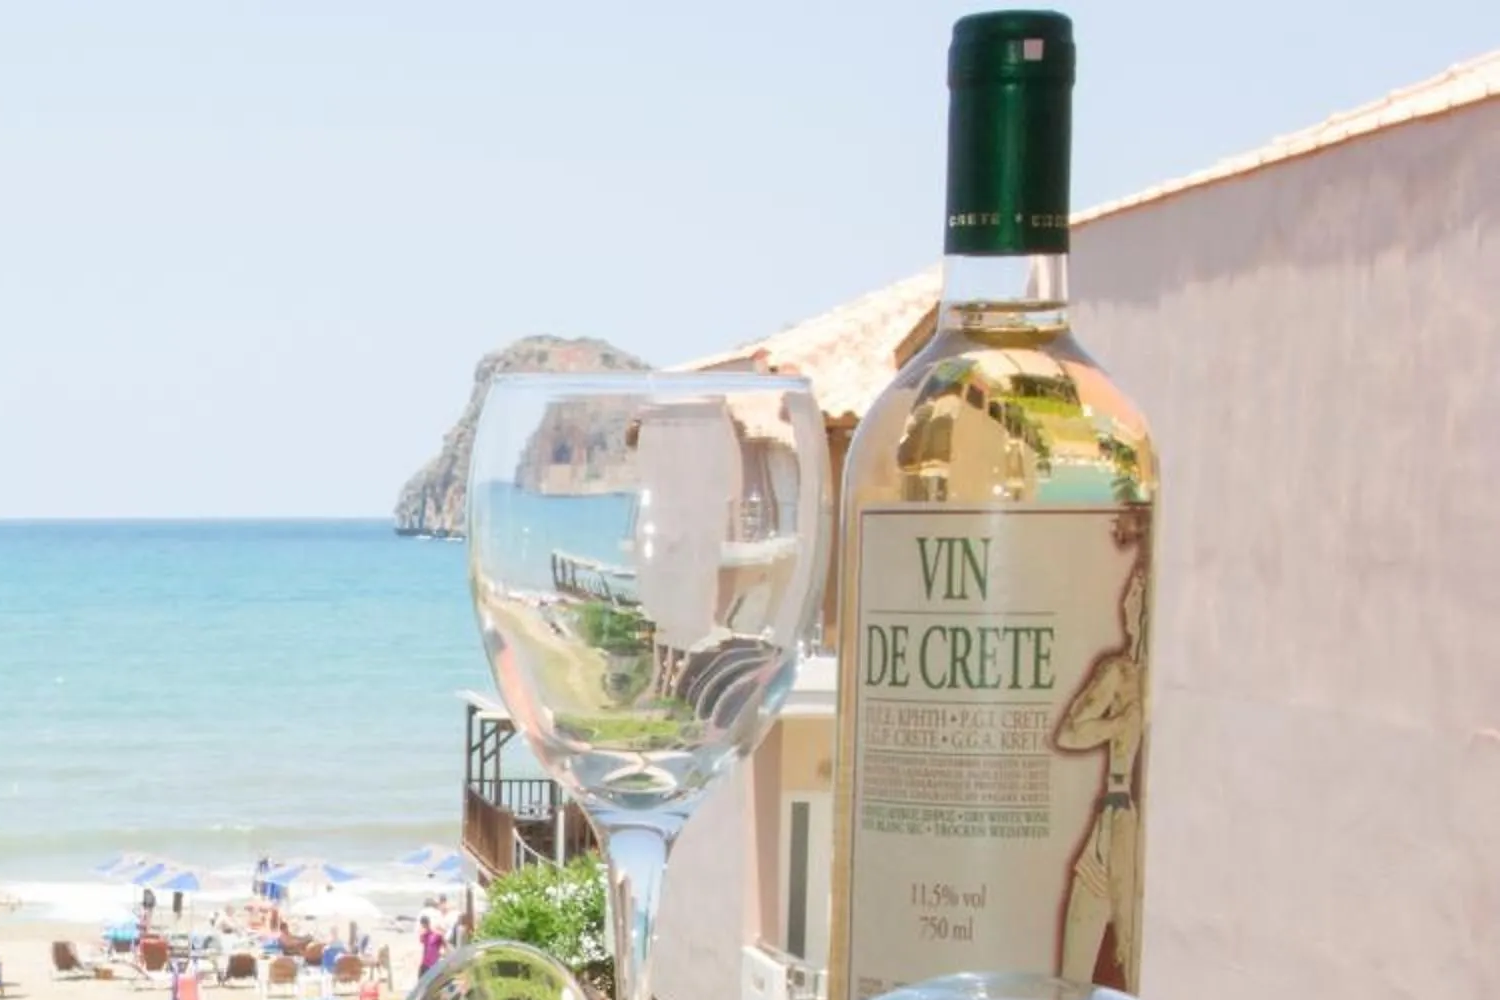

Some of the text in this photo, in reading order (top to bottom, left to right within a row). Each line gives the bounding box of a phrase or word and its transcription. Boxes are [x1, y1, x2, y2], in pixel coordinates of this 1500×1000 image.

[915, 537, 993, 602] VIN
[865, 624, 1056, 691] DE CRETE
[1000, 709, 1050, 730] CRETE
[962, 884, 987, 908] vol
[919, 916, 974, 941] 750 ml
